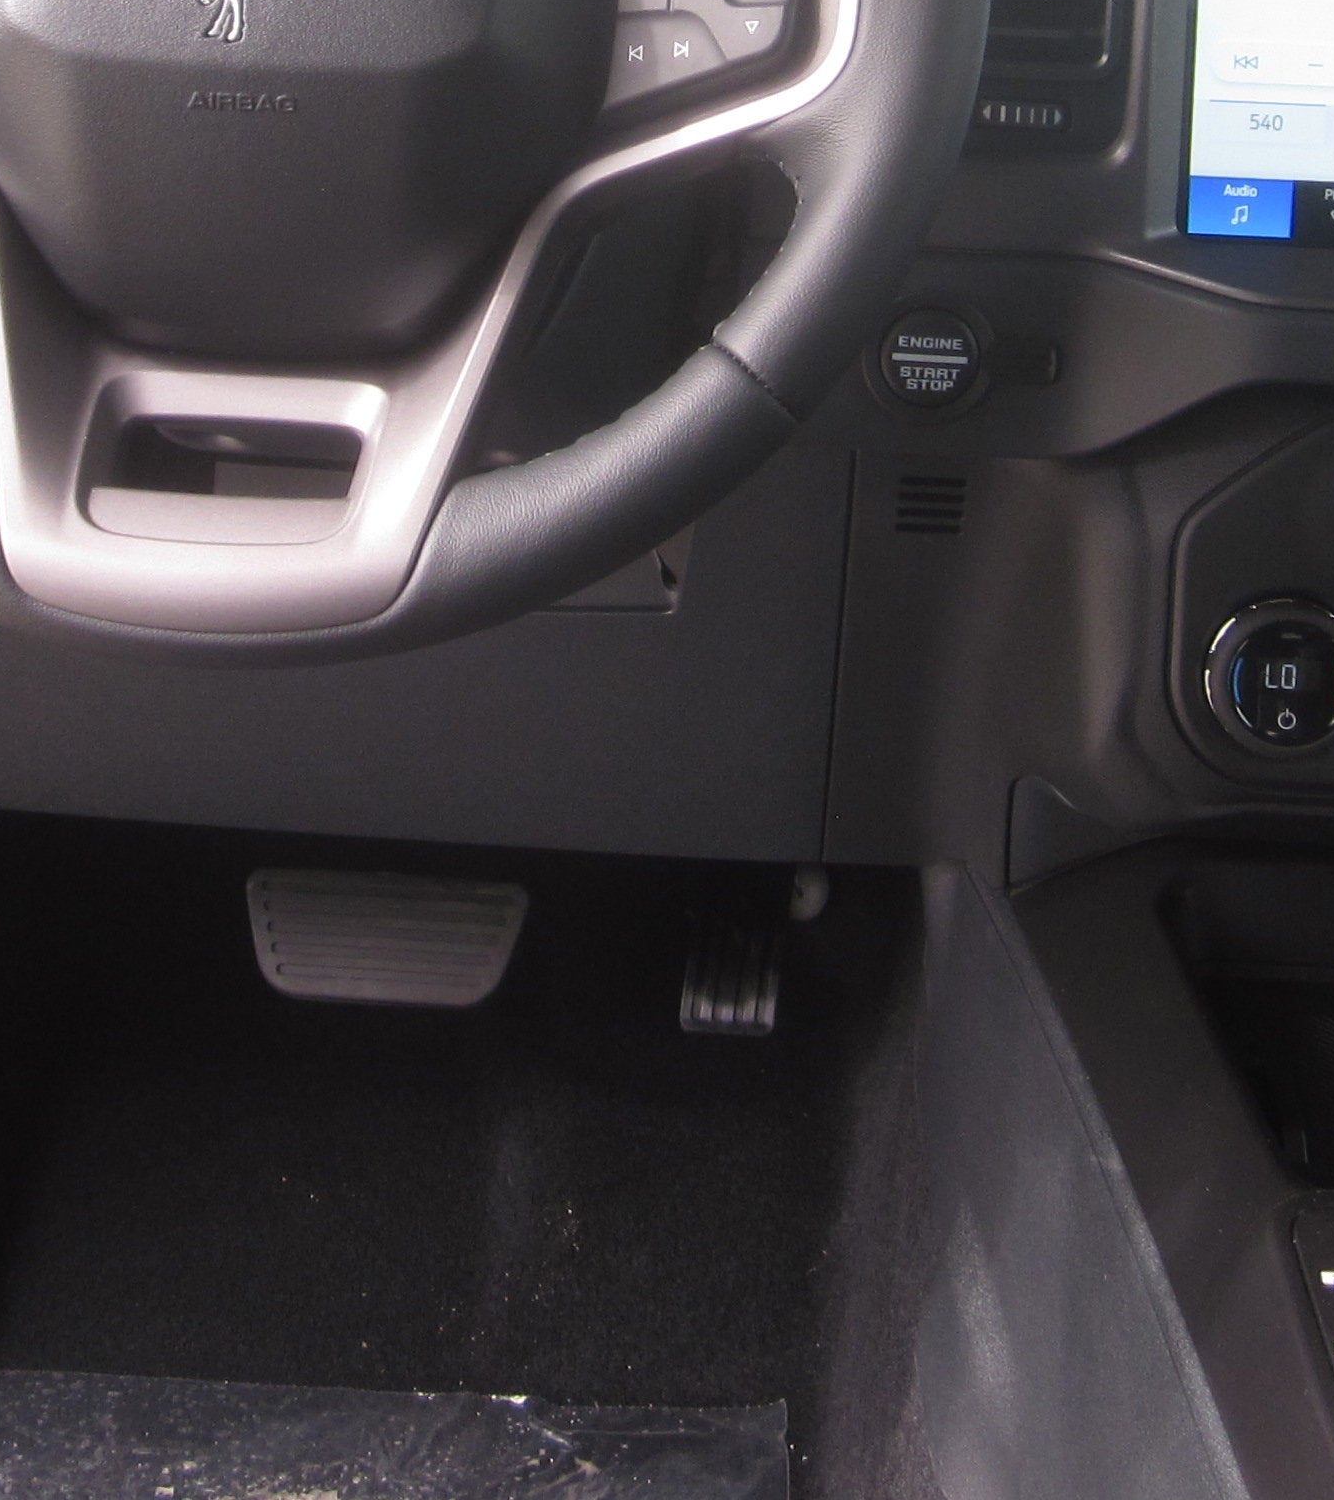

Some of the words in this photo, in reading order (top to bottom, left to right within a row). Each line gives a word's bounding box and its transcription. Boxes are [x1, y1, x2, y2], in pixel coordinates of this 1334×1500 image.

[186, 91, 298, 113] AIRBAG
[1249, 113, 1284, 132] 540
[1223, 184, 1258, 198] Audio
[898, 335, 964, 350] ENGINE
[900, 366, 960, 380] START
[906, 379, 954, 392] STOP
[1265, 663, 1297, 690] LO
